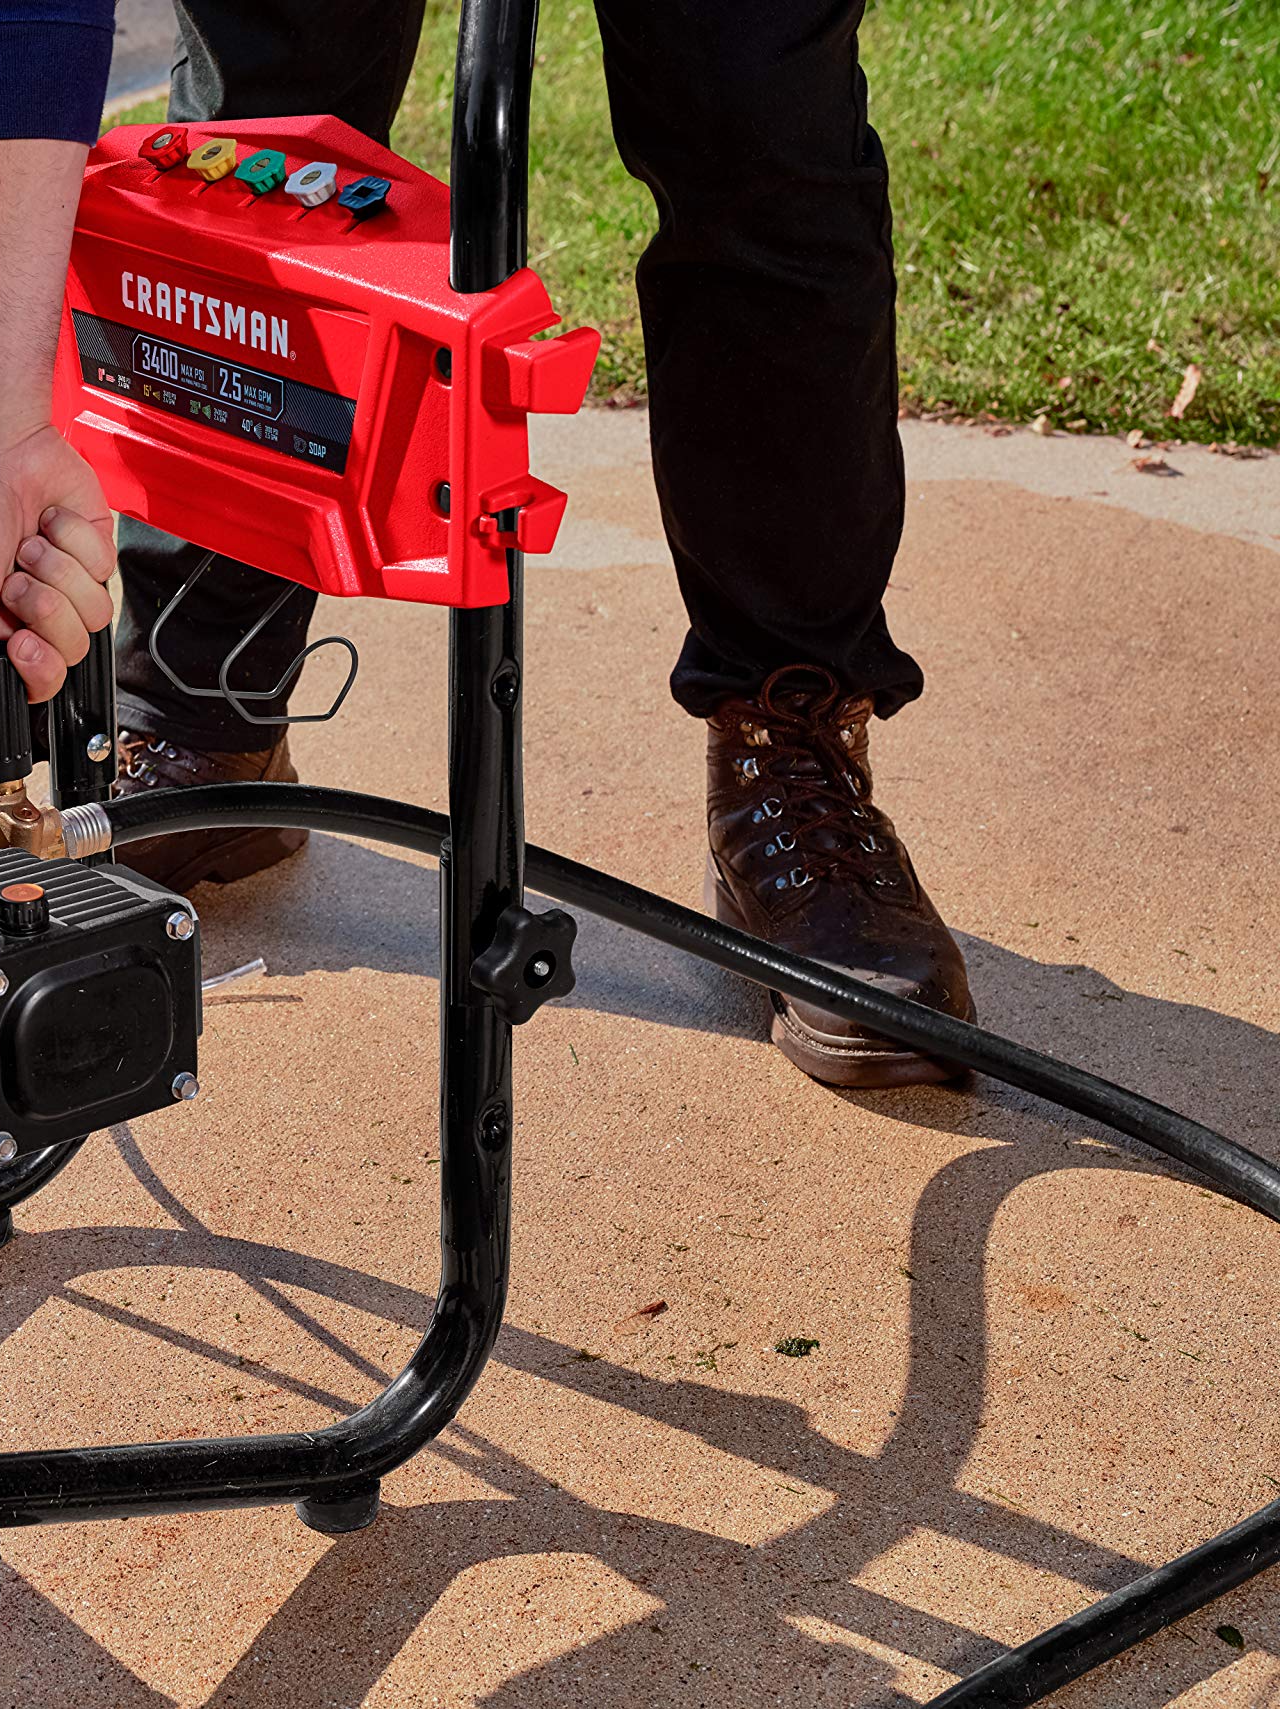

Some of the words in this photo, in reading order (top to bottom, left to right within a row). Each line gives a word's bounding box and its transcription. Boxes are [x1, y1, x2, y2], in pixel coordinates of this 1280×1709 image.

[121, 271, 288, 358] CRAFTSMAN
[141, 342, 178, 380] 3400
[180, 363, 194, 378] MAX
[194, 368, 205, 381] PSI
[219, 367, 241, 402] 2.5
[243, 384, 257, 399] MAX
[258, 389, 272, 405] GPM
[308, 441, 327, 458] SOAP
